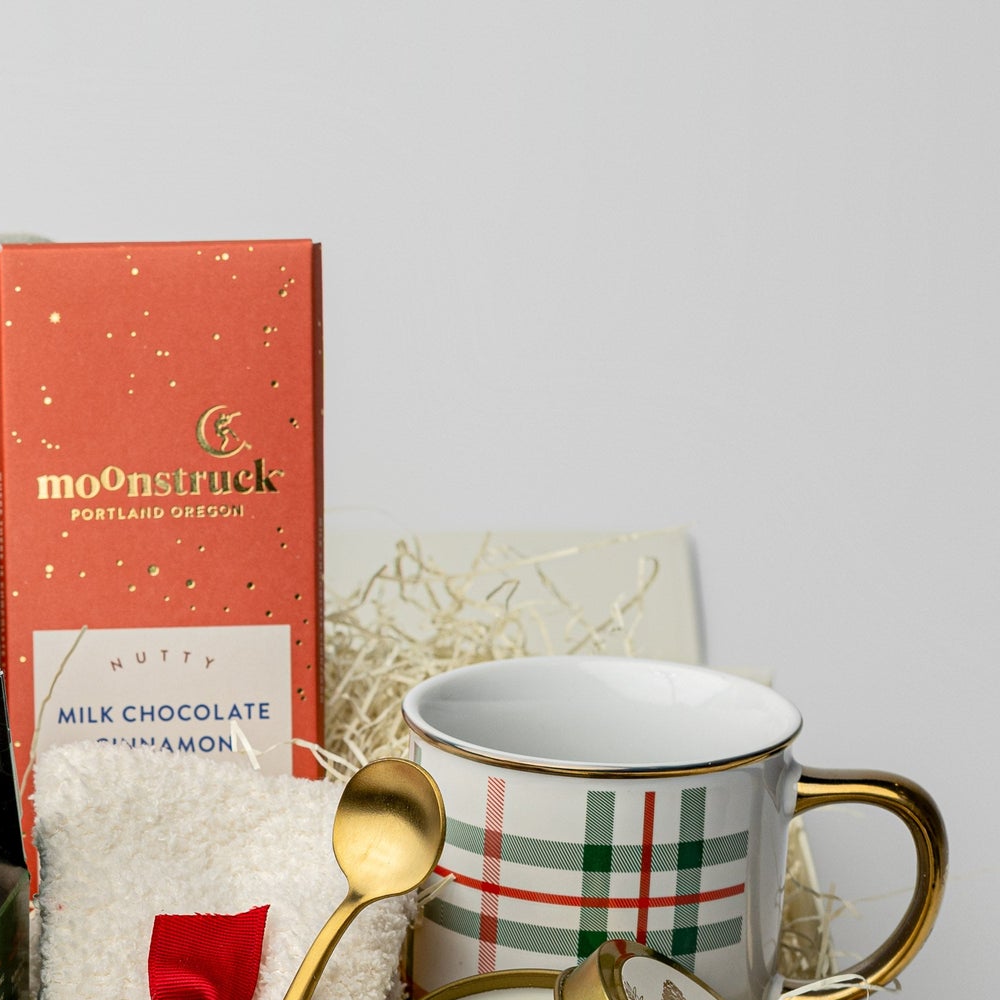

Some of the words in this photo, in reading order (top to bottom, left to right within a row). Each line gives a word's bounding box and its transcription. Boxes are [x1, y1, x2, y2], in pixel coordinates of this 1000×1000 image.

[36, 458, 285, 500] moonstruck
[71, 505, 164, 521] PORTLAND
[170, 504, 244, 519] OREGON
[110, 650, 215, 672] NUTTY
[57, 705, 114, 724] MILK
[121, 703, 271, 723] CHOCOLATE
